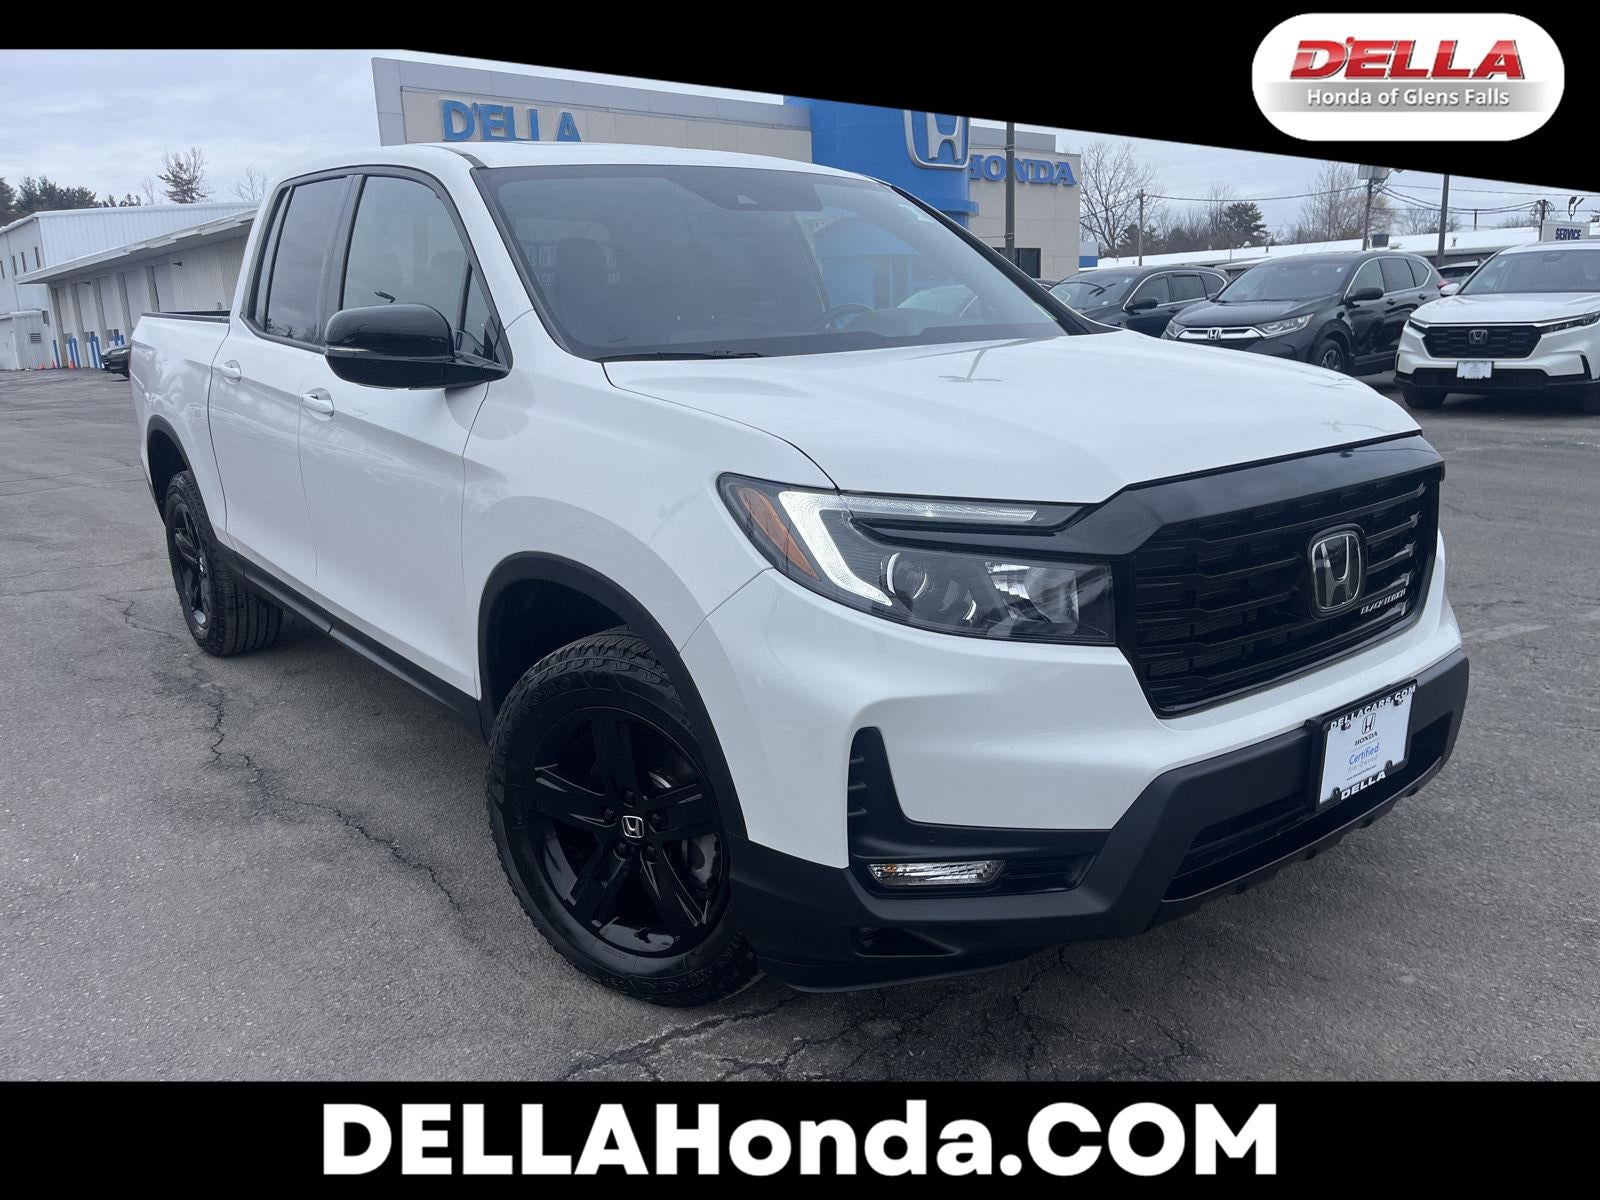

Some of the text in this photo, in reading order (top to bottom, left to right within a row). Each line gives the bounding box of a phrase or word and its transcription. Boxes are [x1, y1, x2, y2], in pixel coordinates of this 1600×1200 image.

[1555, 228, 1582, 240] SERVICE
[1355, 732, 1378, 746] HONDA
[1349, 742, 1379, 765] Certified
[1341, 771, 1386, 800] DELLA
